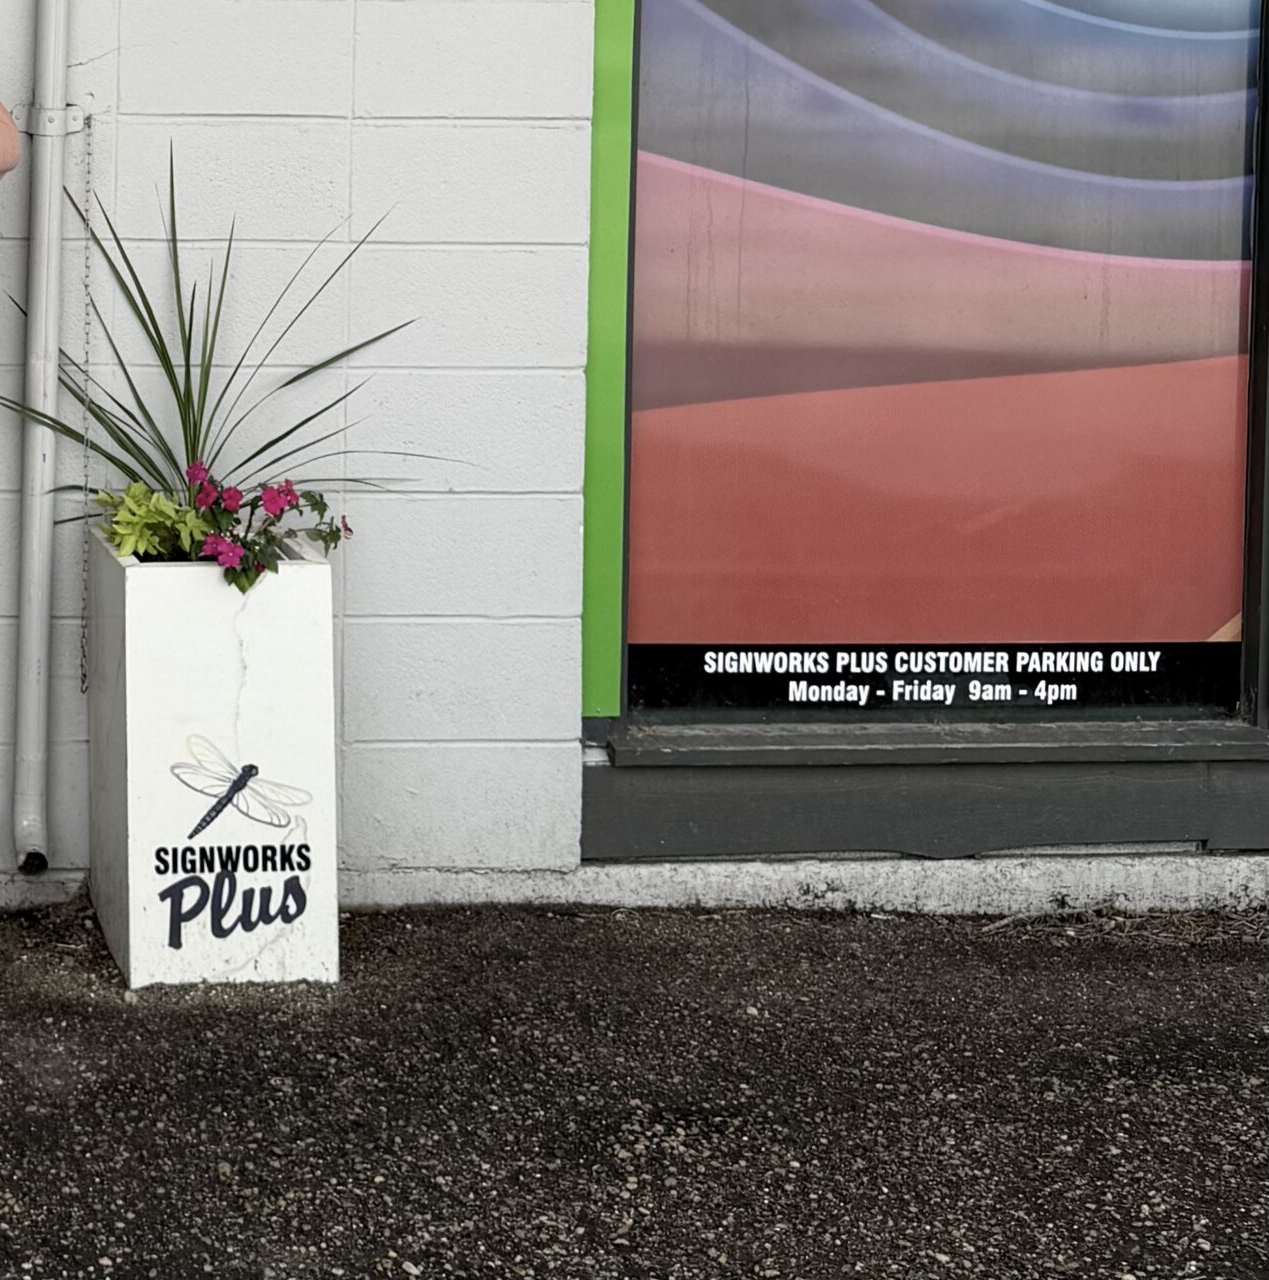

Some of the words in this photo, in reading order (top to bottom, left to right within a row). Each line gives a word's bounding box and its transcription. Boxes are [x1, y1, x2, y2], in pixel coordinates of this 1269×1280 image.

[704, 651, 830, 673] SIGNWORKS
[836, 651, 888, 673] PLUS
[895, 651, 1009, 673] CUSTOMER
[1016, 651, 1104, 672] PARKING
[1110, 651, 1161, 672] ONLY
[788, 680, 870, 706] Monday
[892, 679, 956, 705] Friday
[968, 680, 1012, 701] 9am
[1034, 680, 1077, 705] 4pm
[154, 843, 311, 875] SIGNWORKS
[158, 870, 307, 950] Plus
